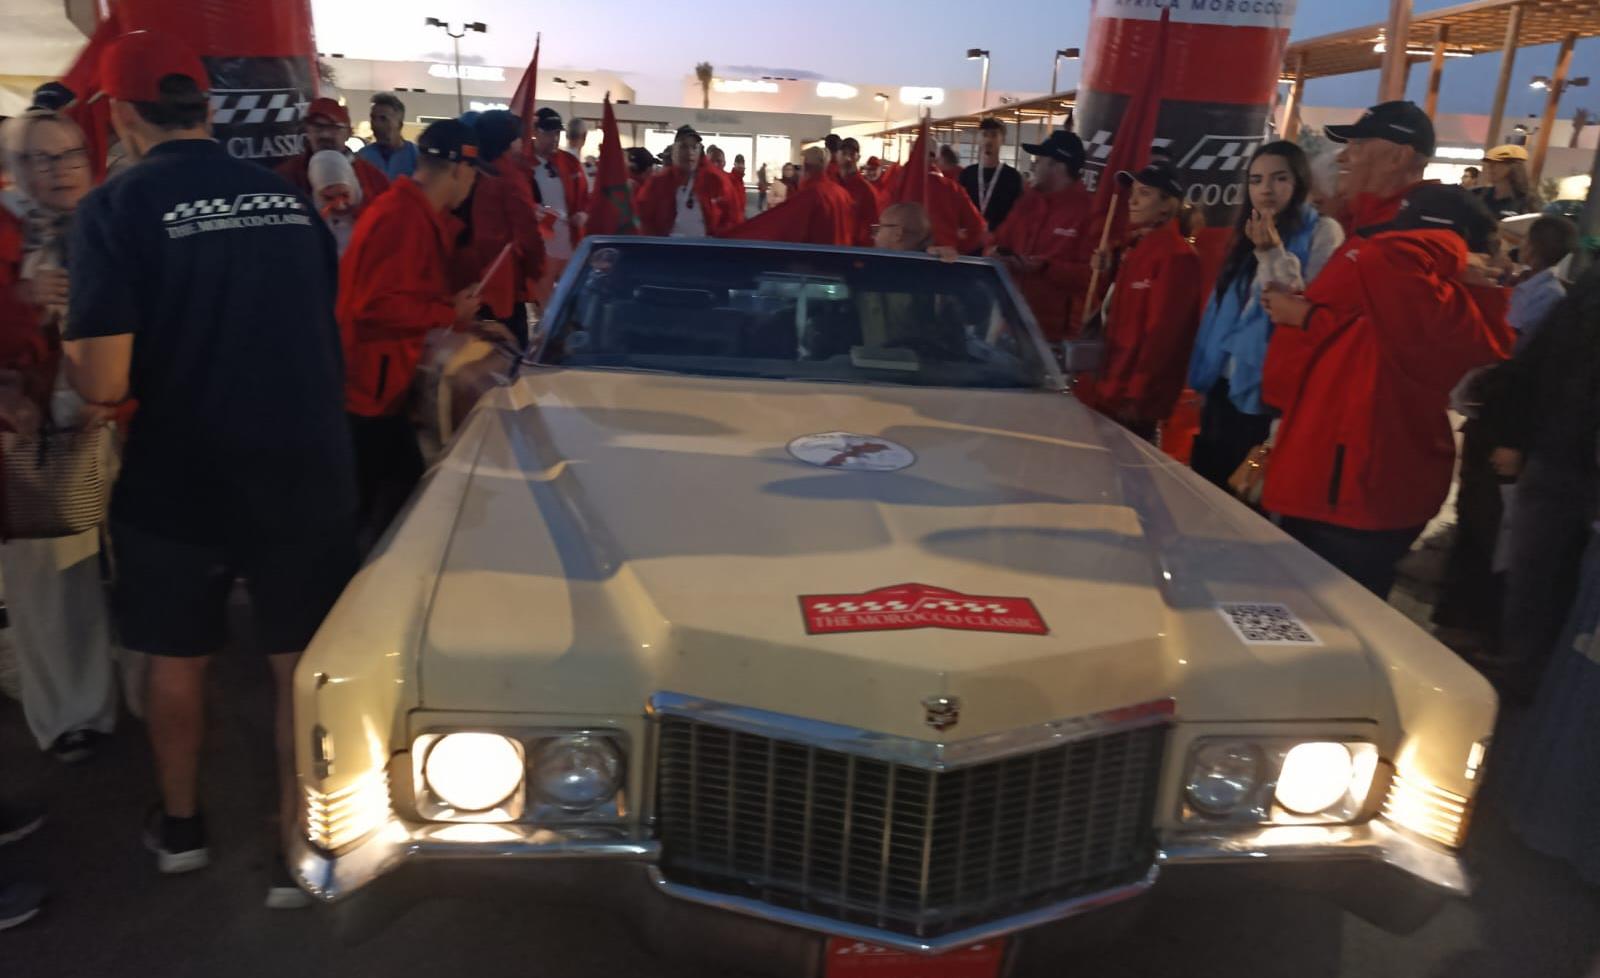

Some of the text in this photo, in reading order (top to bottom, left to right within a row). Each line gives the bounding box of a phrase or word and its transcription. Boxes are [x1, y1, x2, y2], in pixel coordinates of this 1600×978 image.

[815, 612, 1033, 628] THE MOROCCO CLASSIC
